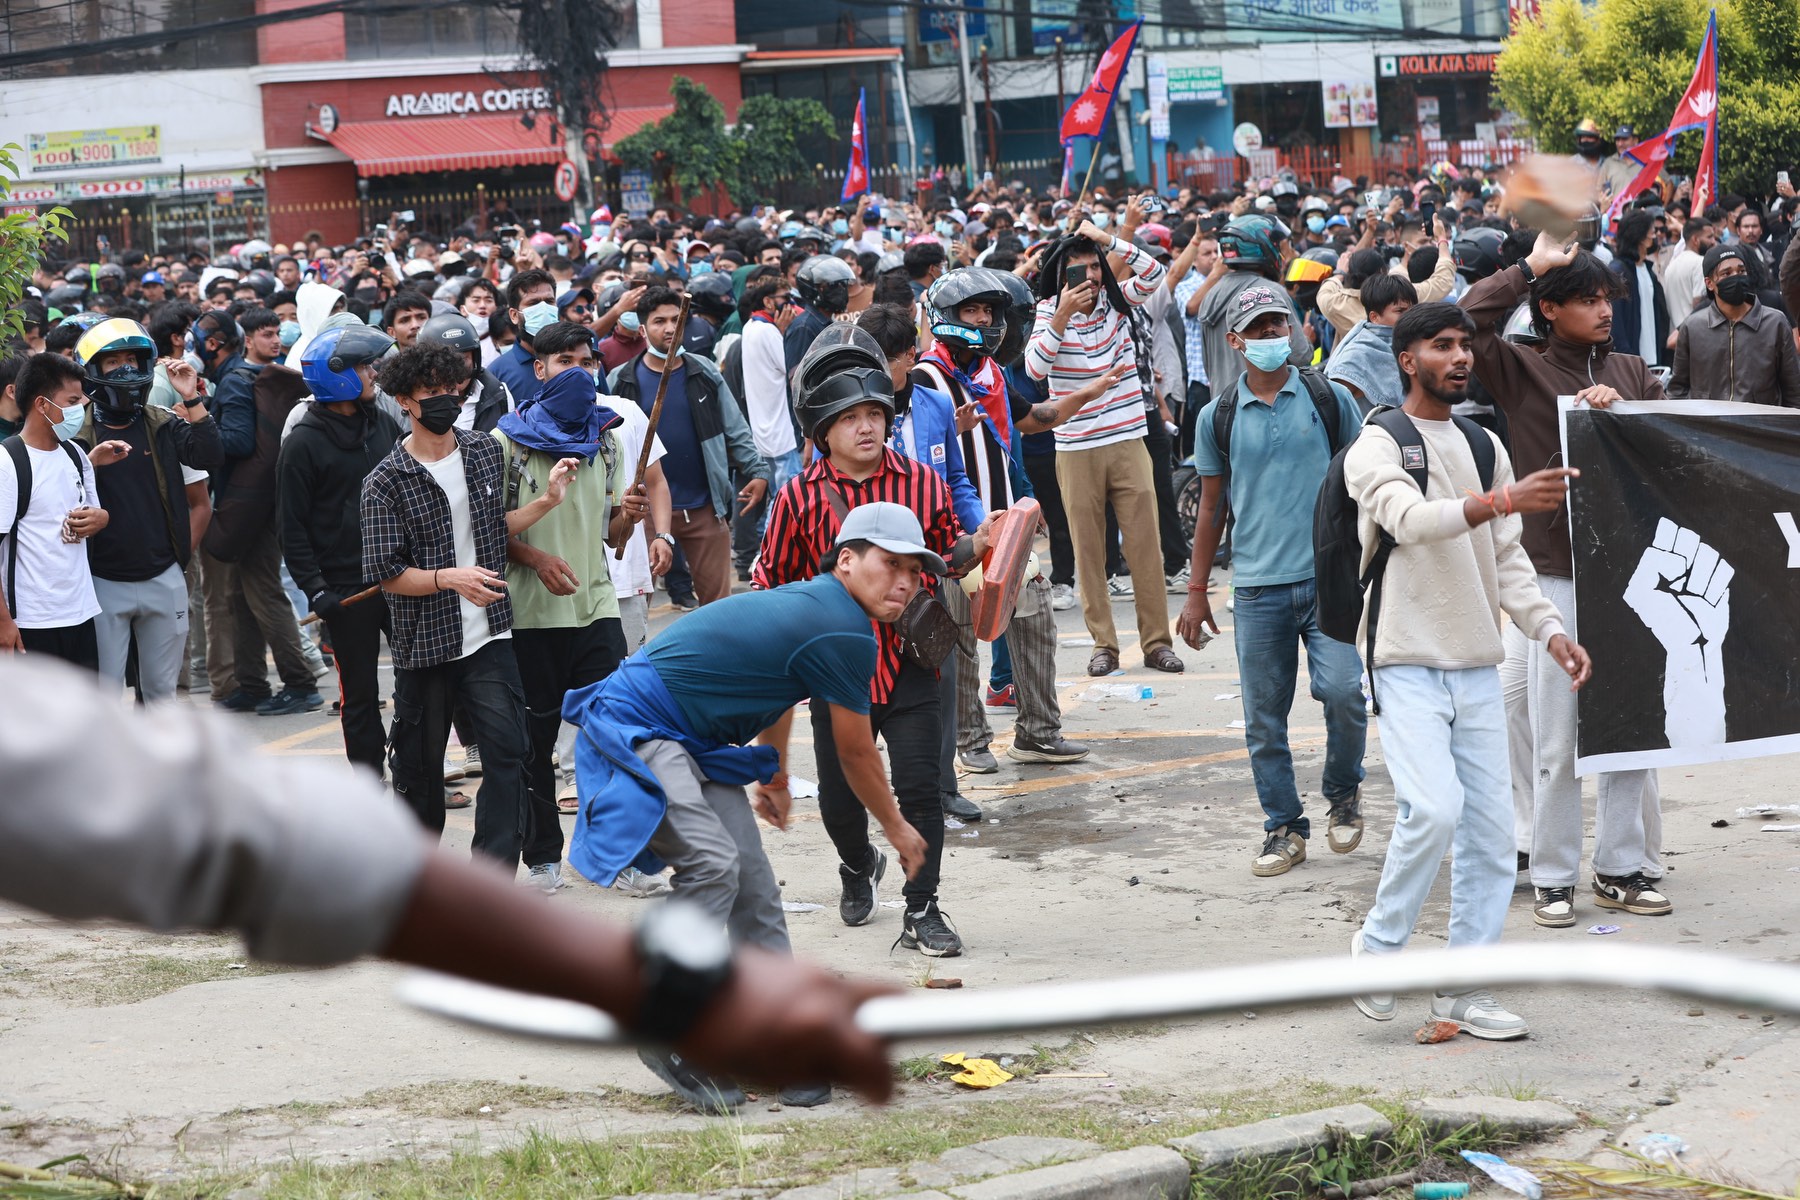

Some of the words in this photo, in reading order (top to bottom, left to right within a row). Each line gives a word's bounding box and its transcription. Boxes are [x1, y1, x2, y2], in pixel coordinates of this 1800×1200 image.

[1399, 55, 1464, 74] KOLKATA
[386, 92, 480, 116] ARABICA
[34, 152, 69, 164] 100
[82, 143, 110, 160] 900
[128, 141, 158, 156] 1800
[10, 190, 54, 201] 100
[80, 180, 144, 196] 900
[188, 177, 232, 189] 1800
